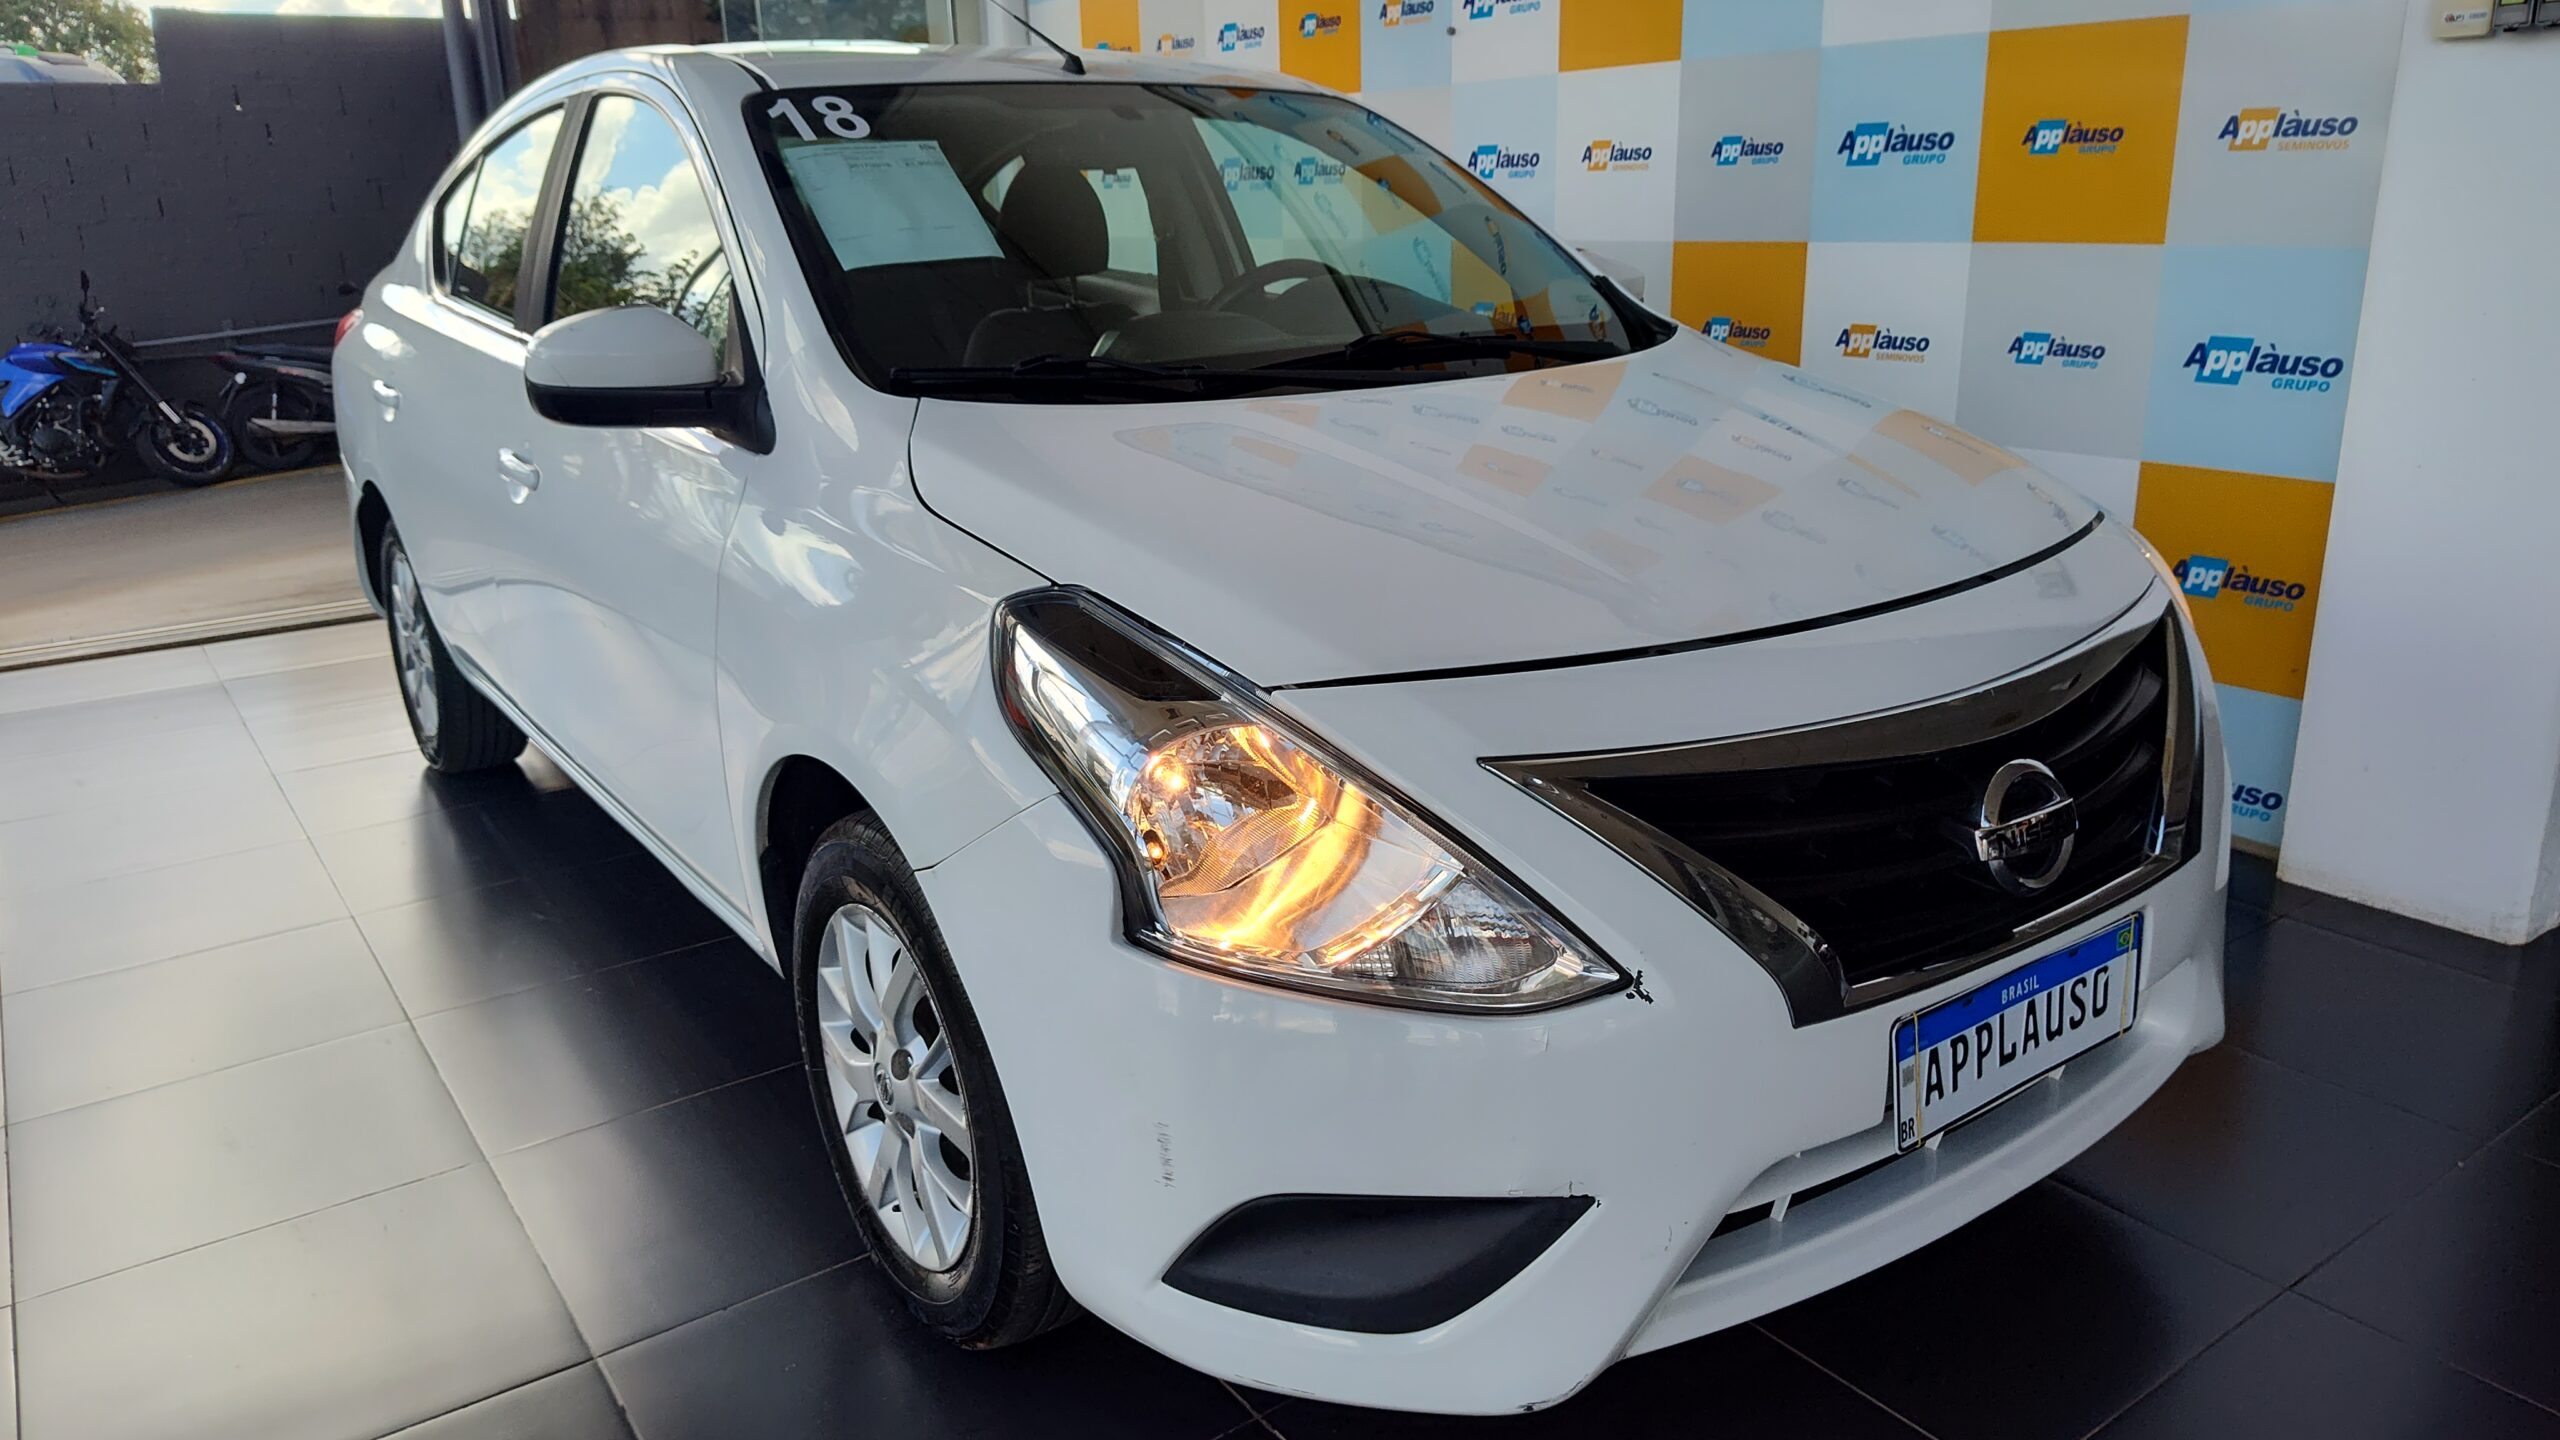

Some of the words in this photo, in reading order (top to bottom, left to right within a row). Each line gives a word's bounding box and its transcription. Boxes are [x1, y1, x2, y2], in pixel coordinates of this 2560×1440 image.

[766, 95, 871, 141] 18
[2078, 144, 2117, 154] GRUPO
[2278, 139, 2349, 151] SEMINOVOS
[1751, 155, 1778, 165] GRUPO
[1903, 153, 1946, 165] GRUPO
[1508, 169, 1536, 179] GRUPO
[1876, 351, 1924, 363] SEMINOVOS
[2062, 359, 2098, 369] GRUPO
[2272, 378, 2331, 392] GRUPO
[2244, 595, 2294, 611] GRUPO
[2232, 803, 2270, 821] RUPO
[2001, 975, 2040, 1004] BRASIL
[1925, 965, 2109, 1107] APPLAUSO
[1901, 1117, 1915, 1143] BR
